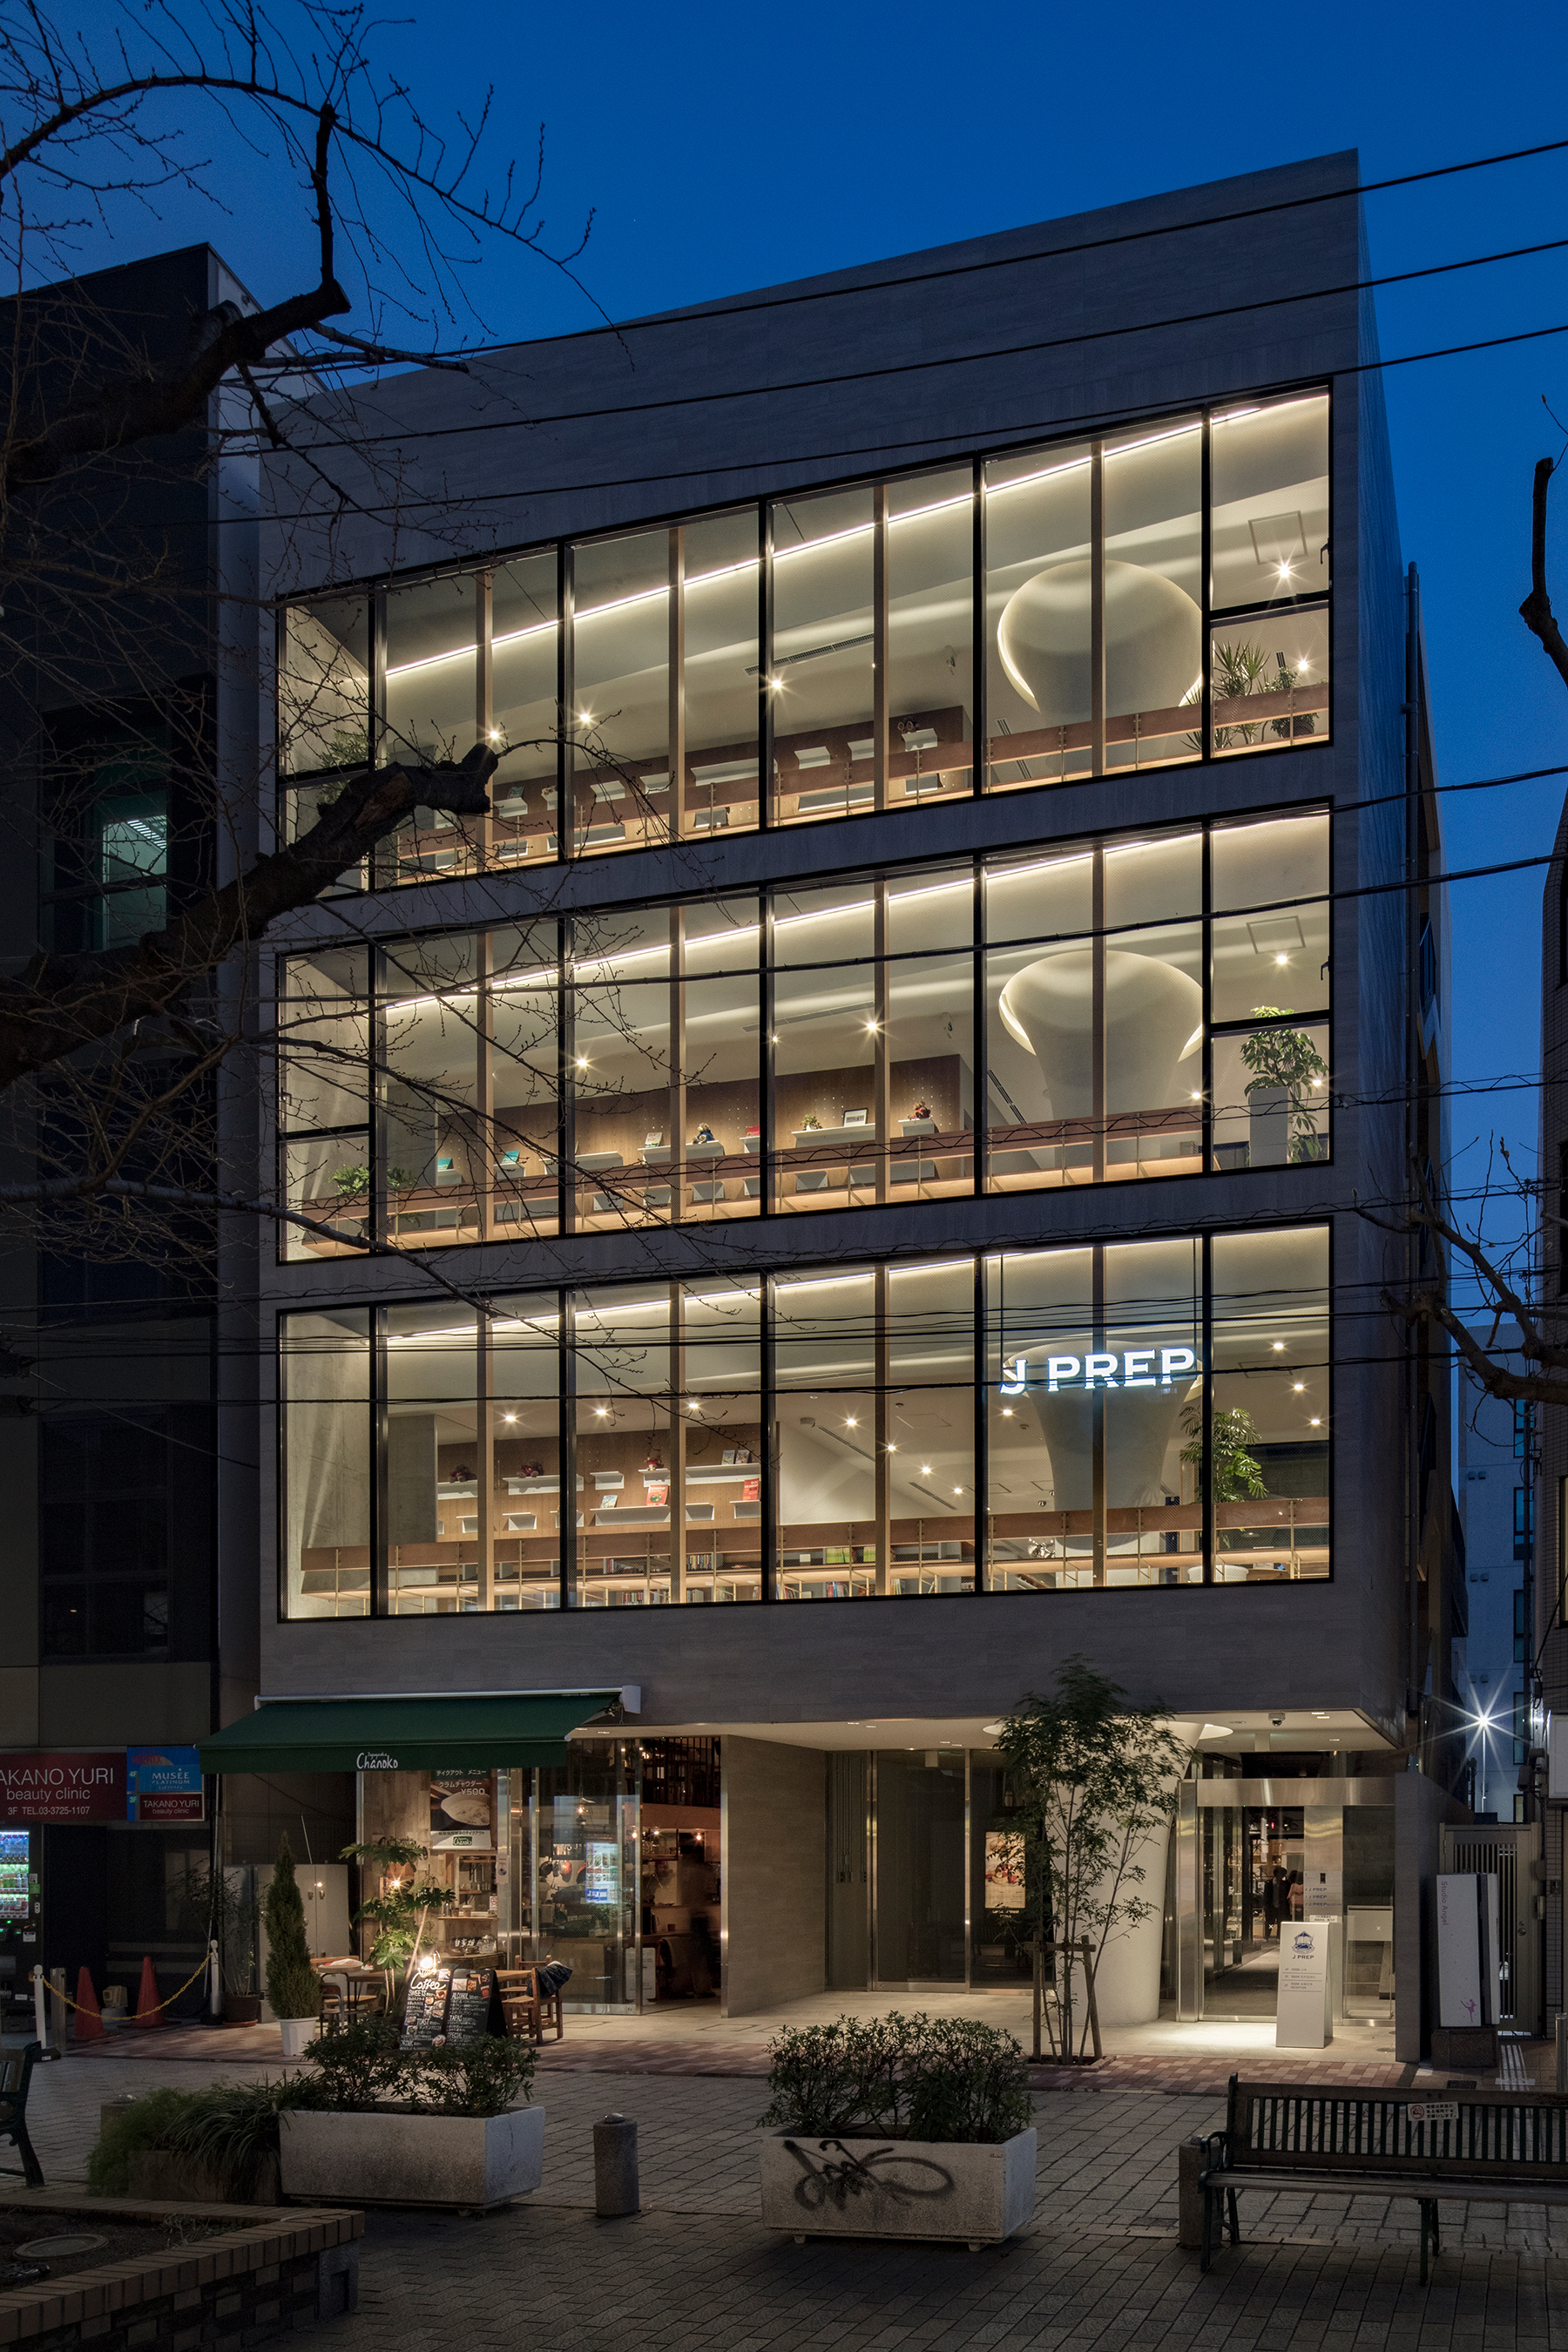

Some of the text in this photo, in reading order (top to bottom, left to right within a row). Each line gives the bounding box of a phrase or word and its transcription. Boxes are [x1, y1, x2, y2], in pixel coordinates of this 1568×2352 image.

[999, 1347, 1195, 1396] J PREP
[132, 1754, 162, 1764] MERIX
[356, 1752, 399, 1769] Chanoko
[68, 1767, 113, 1785] YURI
[6, 1787, 91, 1802] beauty clinic
[8, 1806, 91, 1815] 3F TEL.03-3725-1107
[1440, 1905, 1449, 1926] Angel
[409, 1971, 446, 1990] Coffee
